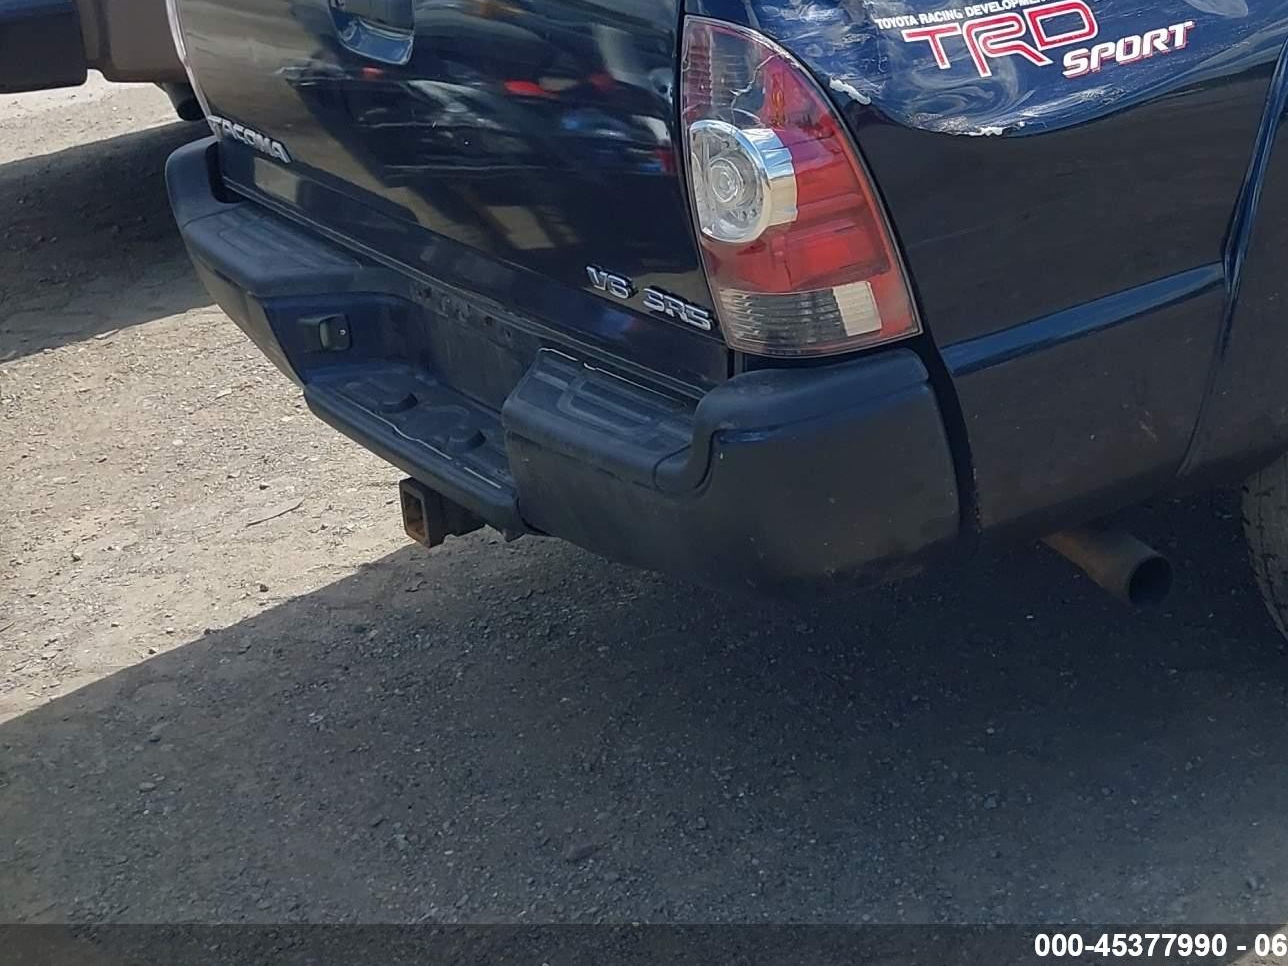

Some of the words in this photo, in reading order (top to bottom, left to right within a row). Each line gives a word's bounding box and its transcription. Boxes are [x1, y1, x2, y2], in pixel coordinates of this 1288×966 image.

[875, 15, 918, 30] TOYOTA
[919, 8, 964, 25] RACING
[1061, 20, 1197, 78] SPORT
[206, 114, 292, 164] TACOMA
[586, 265, 632, 299] V6
[643, 288, 714, 332] SR5
